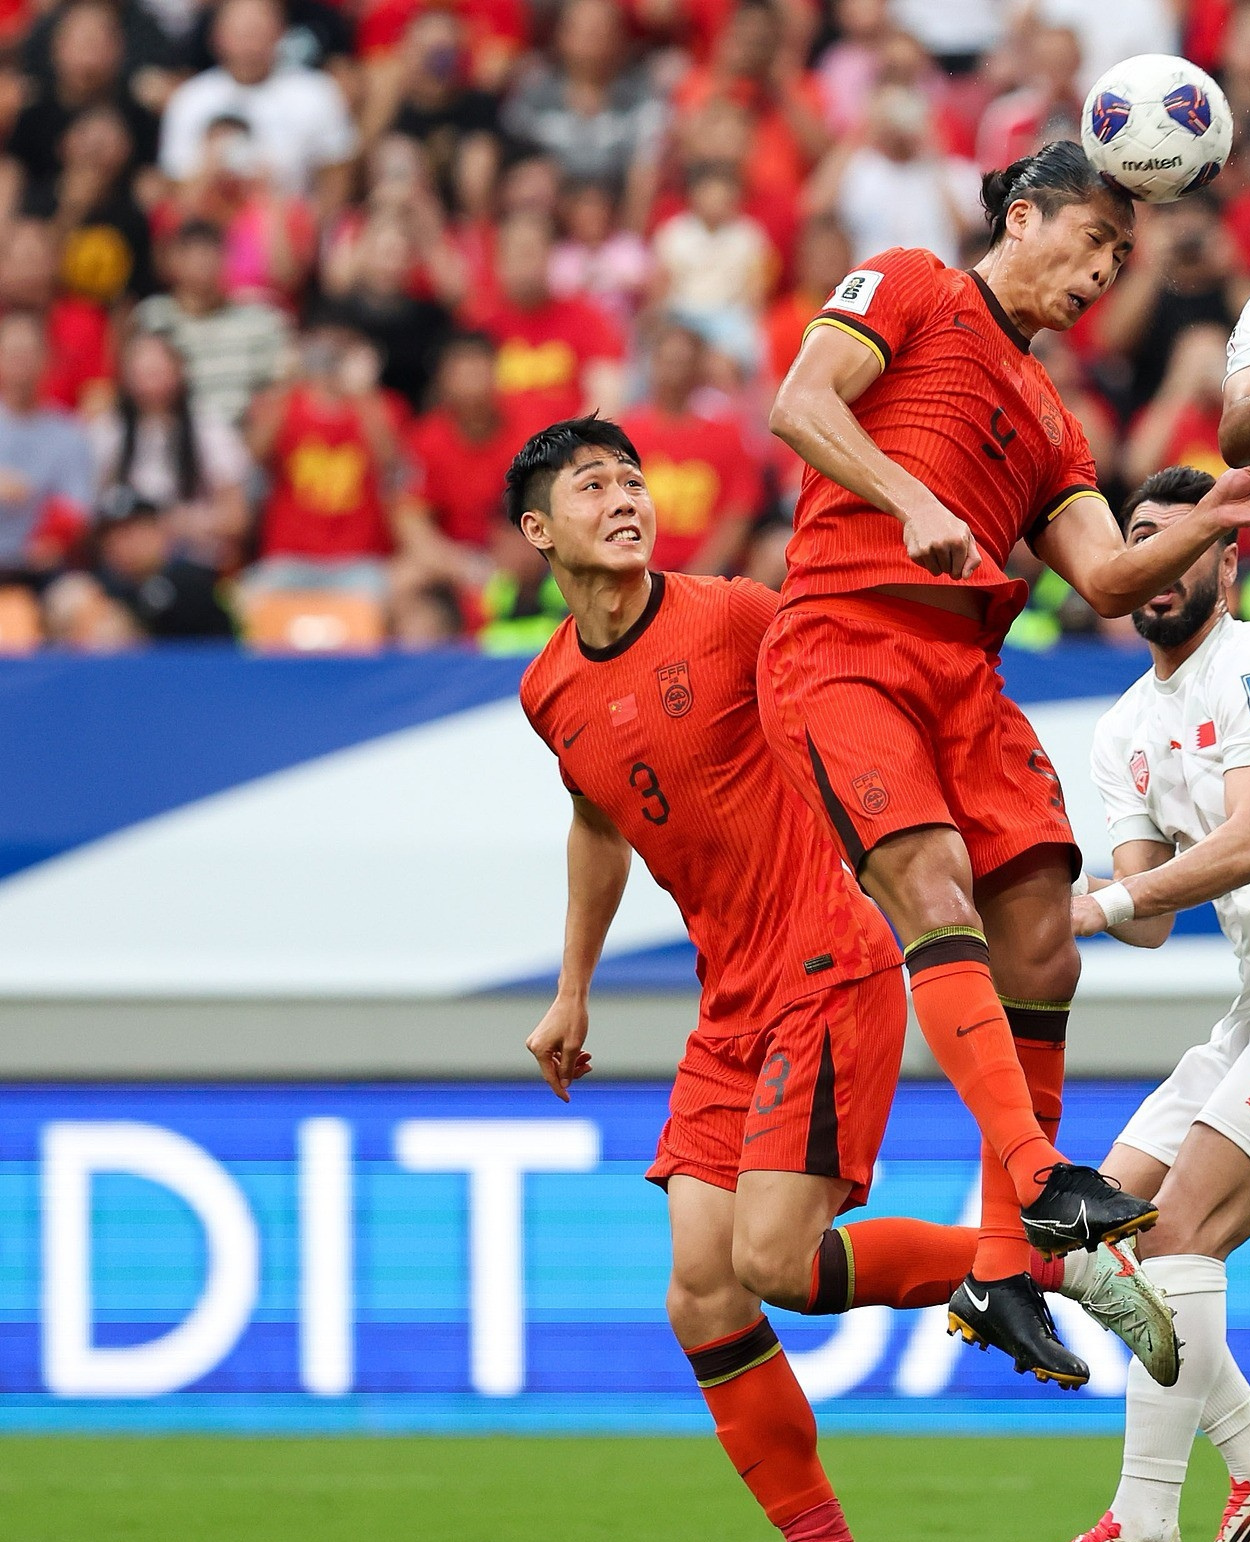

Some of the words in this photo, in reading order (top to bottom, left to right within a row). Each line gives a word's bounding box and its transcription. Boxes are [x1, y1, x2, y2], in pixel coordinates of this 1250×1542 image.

[1121, 154, 1183, 171] molten
[629, 761, 671, 826] 3
[754, 1052, 792, 1115] 3
[40, 1115, 600, 1398] DIT
